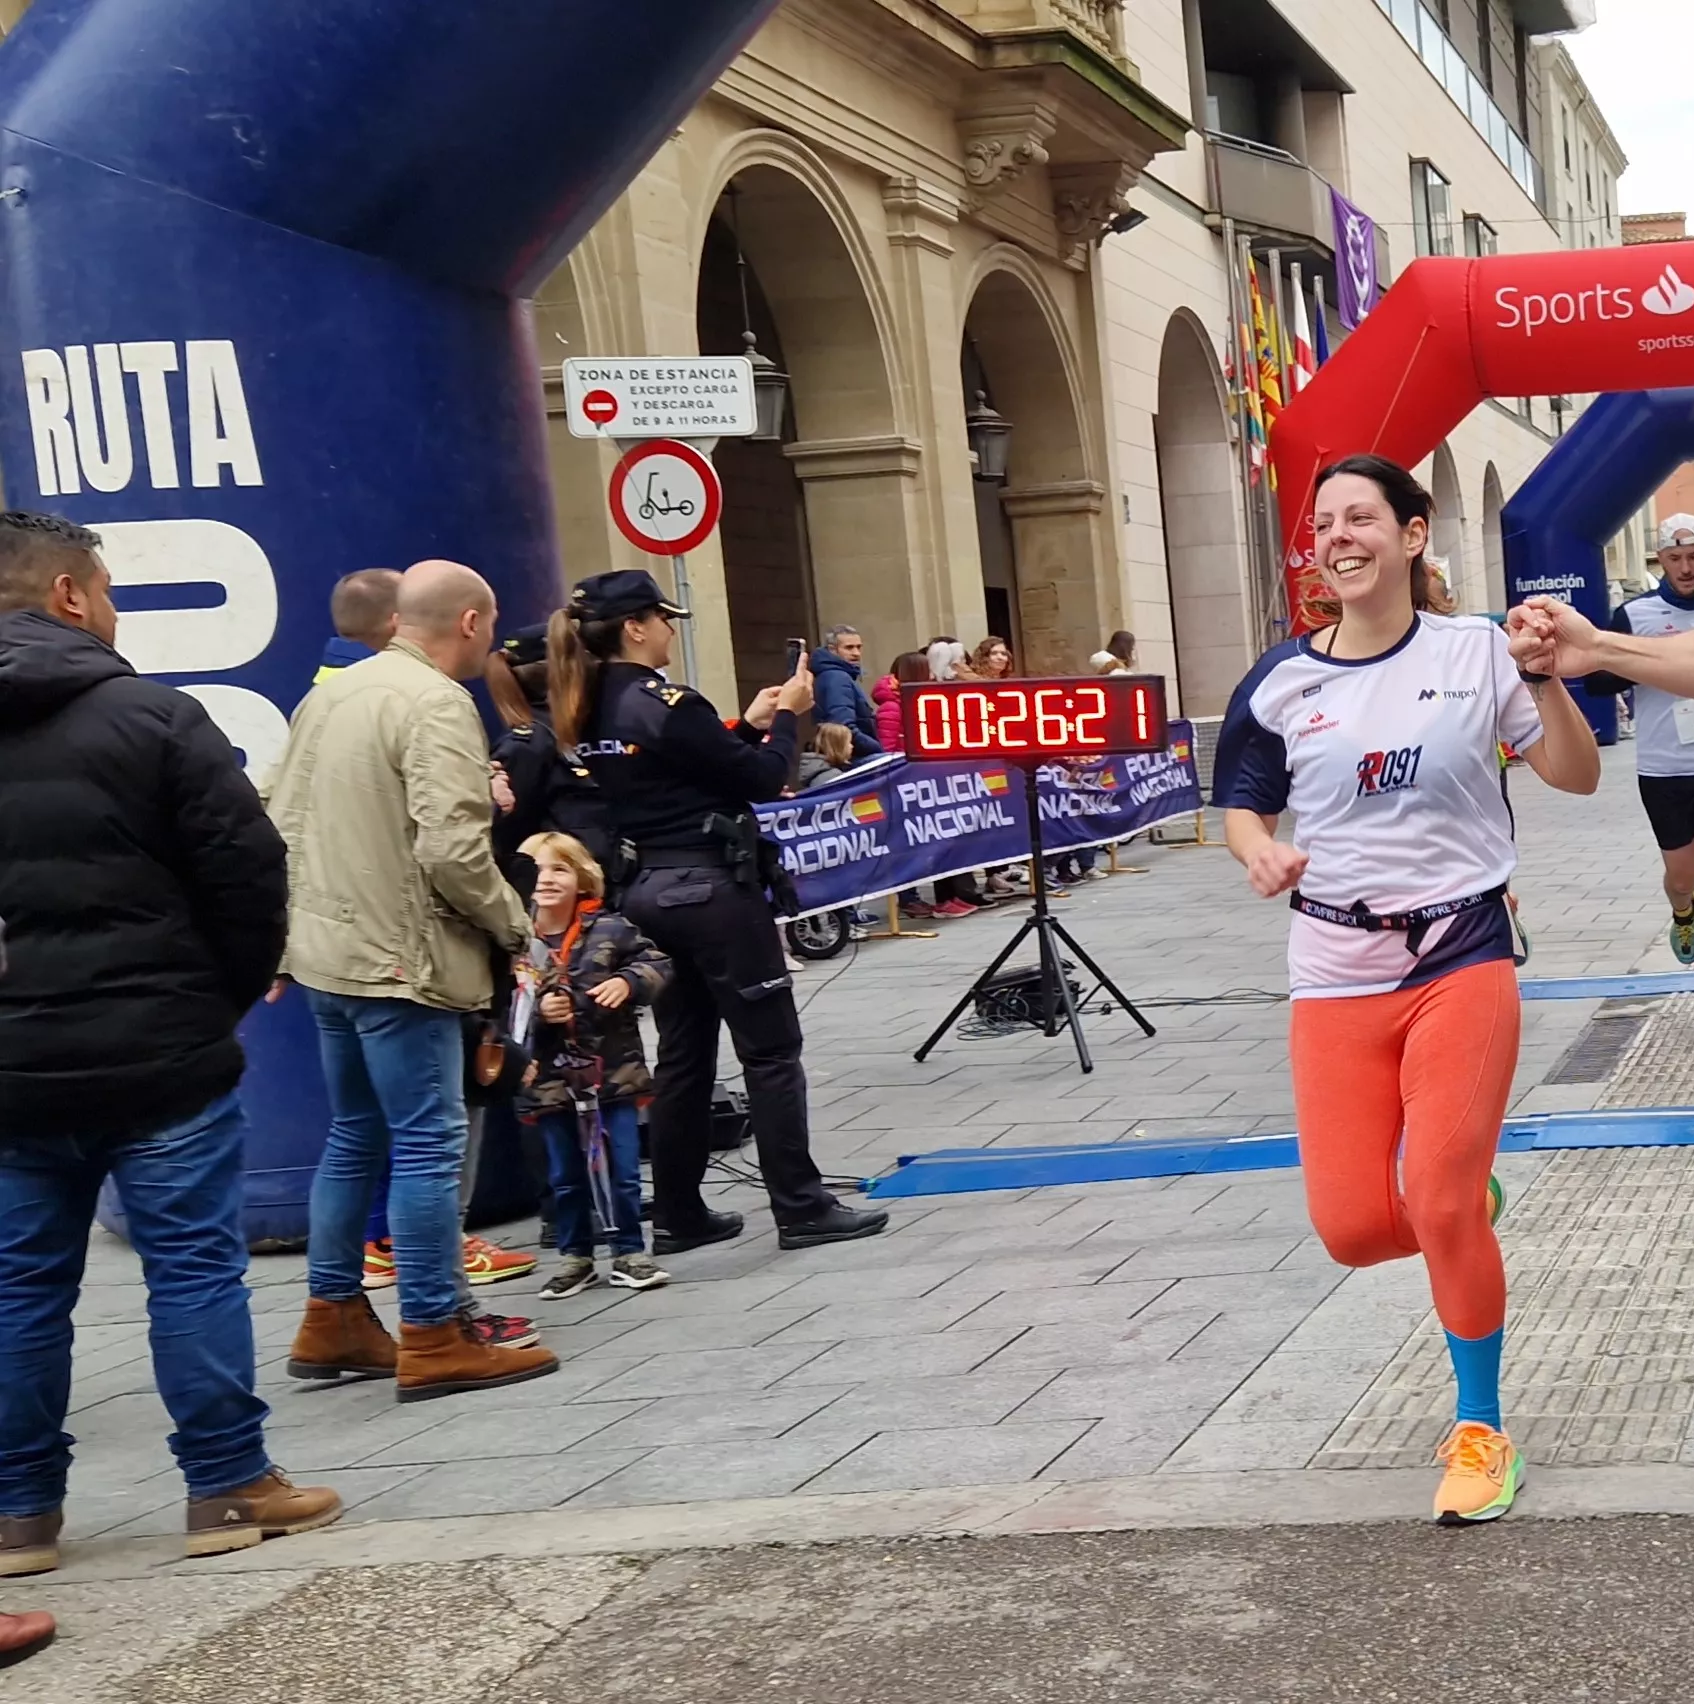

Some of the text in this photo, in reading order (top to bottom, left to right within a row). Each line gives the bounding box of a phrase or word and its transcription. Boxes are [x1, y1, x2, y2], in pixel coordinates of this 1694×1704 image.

[1495, 285, 1634, 337] Sports
[579, 368, 738, 381] ZONA DE ESTANCIA
[630, 384, 738, 395] EXCEPTO CARGA
[632, 400, 714, 410] Y DESCARGA
[21, 340, 264, 496] RUTA
[632, 415, 737, 426] DE 9 A 11 HORAS
[1516, 573, 1585, 592] fundación
[1443, 687, 1478, 702] mupol
[917, 687, 1148, 750] 00:26:21
[903, 800, 1015, 847] NACIONAL
[778, 827, 890, 876] ACIONAL
